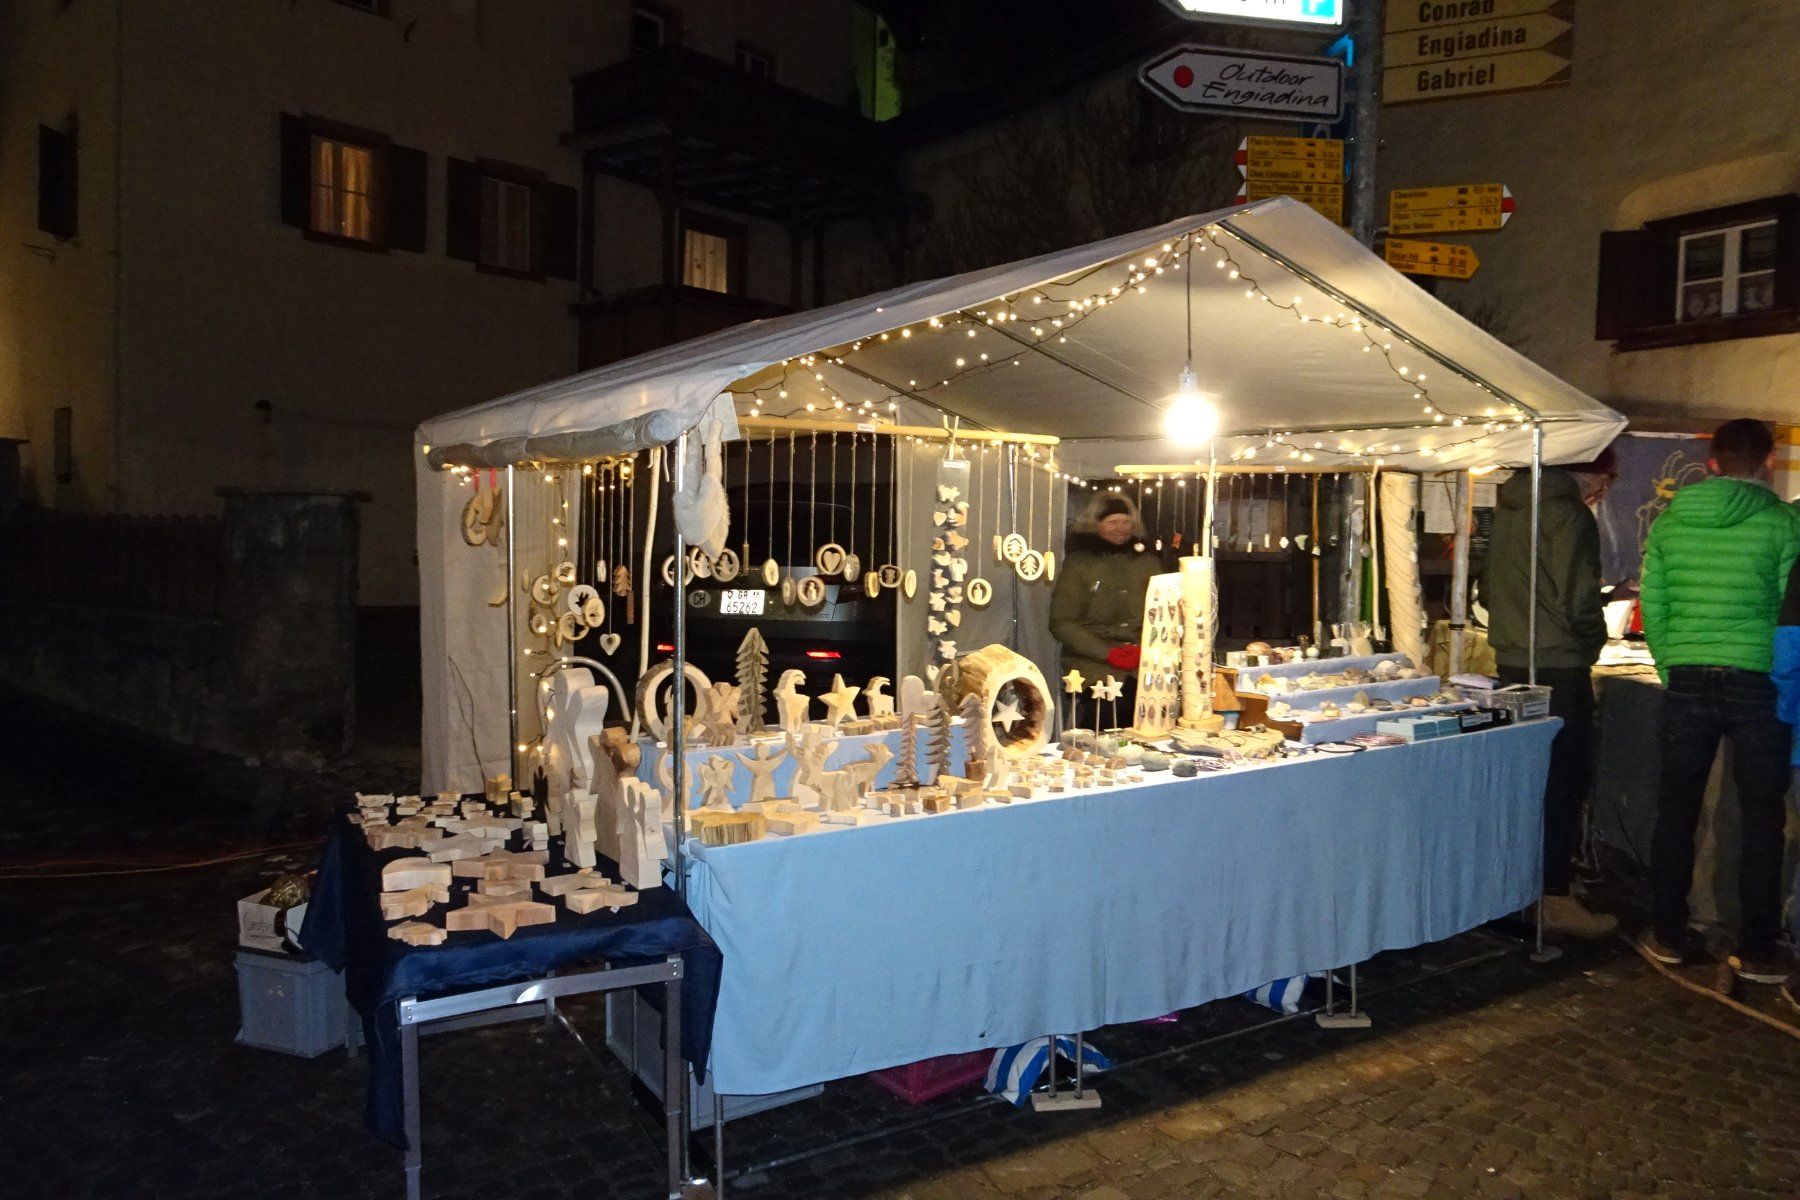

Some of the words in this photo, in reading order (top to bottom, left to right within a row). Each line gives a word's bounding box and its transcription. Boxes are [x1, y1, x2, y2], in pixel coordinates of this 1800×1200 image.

[1418, 0, 1495, 23] Conrad
[1417, 26, 1528, 58] Engiadina
[1218, 63, 1315, 87] Outdoor
[1416, 63, 1496, 93] Gabriel
[1201, 81, 1331, 108] Engiadina
[726, 601, 759, 614] 65262
